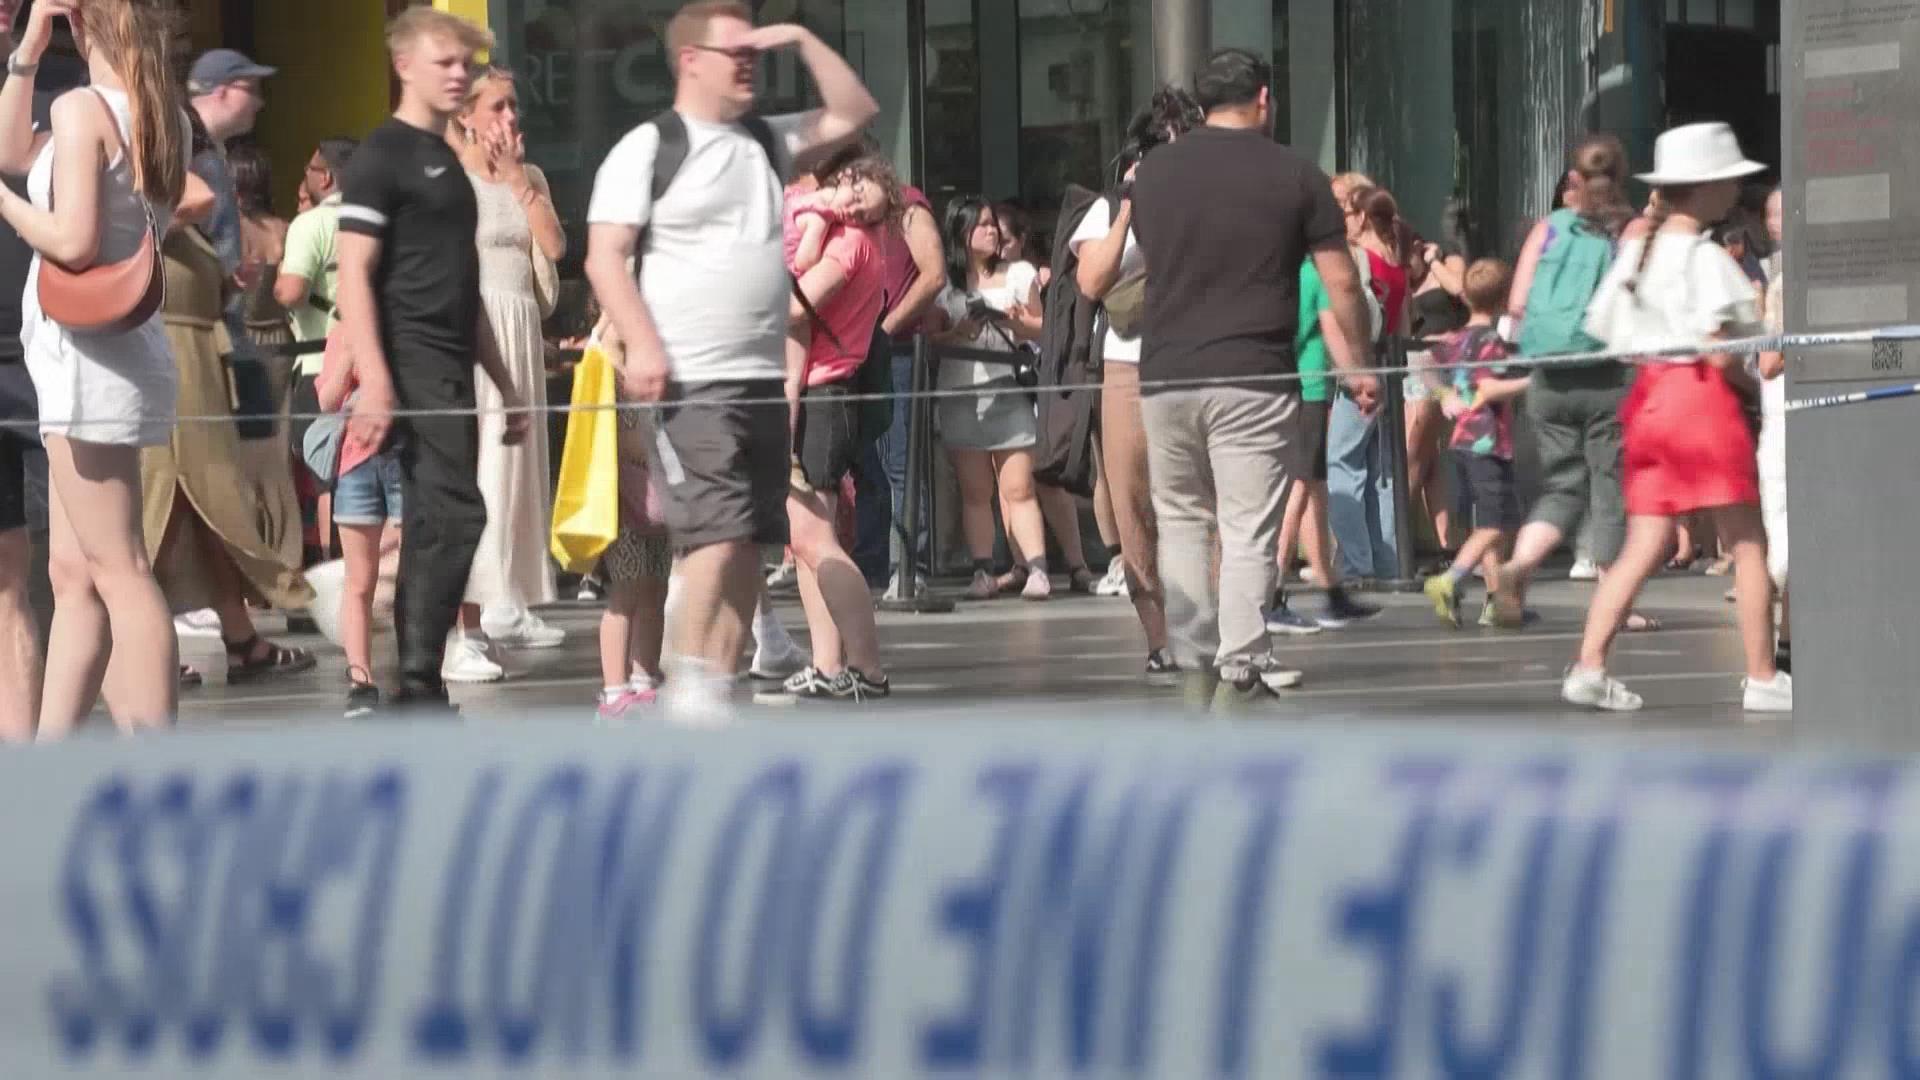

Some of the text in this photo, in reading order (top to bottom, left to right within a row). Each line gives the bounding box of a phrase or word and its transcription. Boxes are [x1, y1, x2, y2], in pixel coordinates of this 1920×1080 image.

[46, 766, 408, 1062] CROSS
[412, 764, 692, 1063] NOT
[691, 756, 915, 1066] DO
[915, 754, 1303, 1078] LINE
